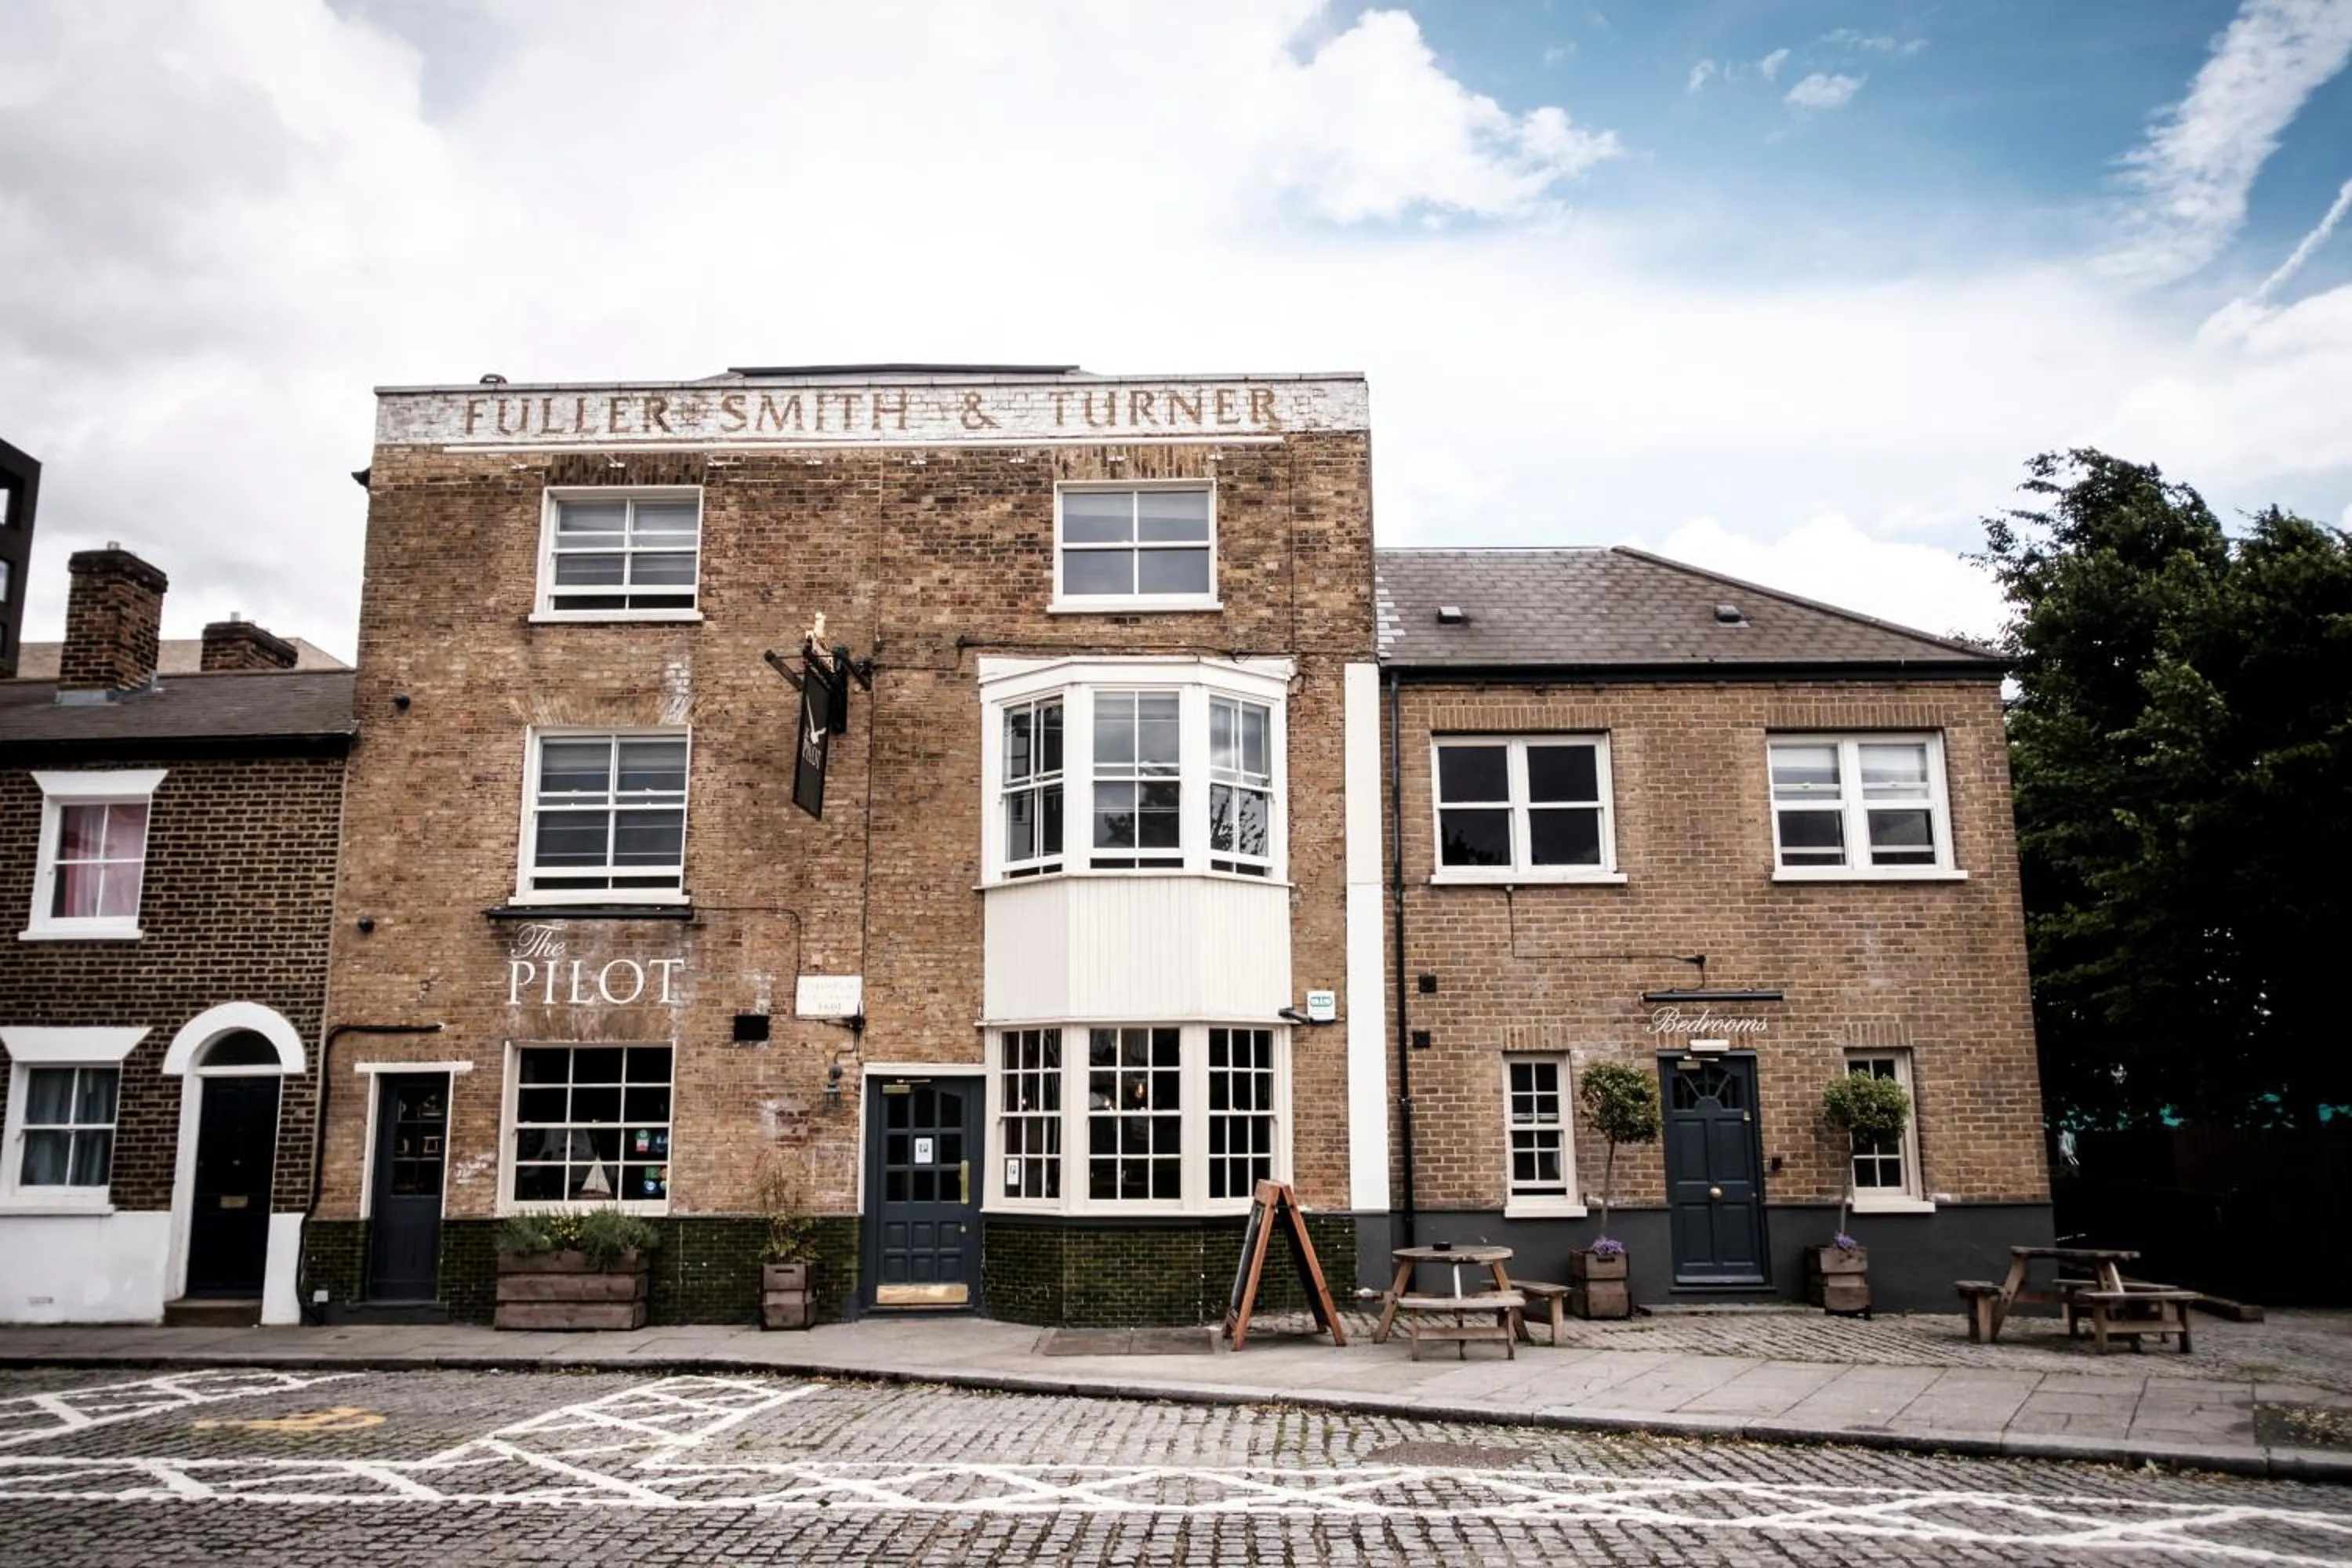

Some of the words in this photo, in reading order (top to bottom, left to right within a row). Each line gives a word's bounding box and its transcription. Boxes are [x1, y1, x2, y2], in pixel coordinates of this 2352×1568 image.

[465, 395, 672, 437] FULLER
[719, 391, 908, 432] SMITH
[960, 392, 1002, 430] &
[1048, 388, 1281, 430] TURNER
[510, 923, 568, 960] The
[505, 958, 684, 1005] PILOT
[1646, 1006, 1769, 1034] Bedrooms
